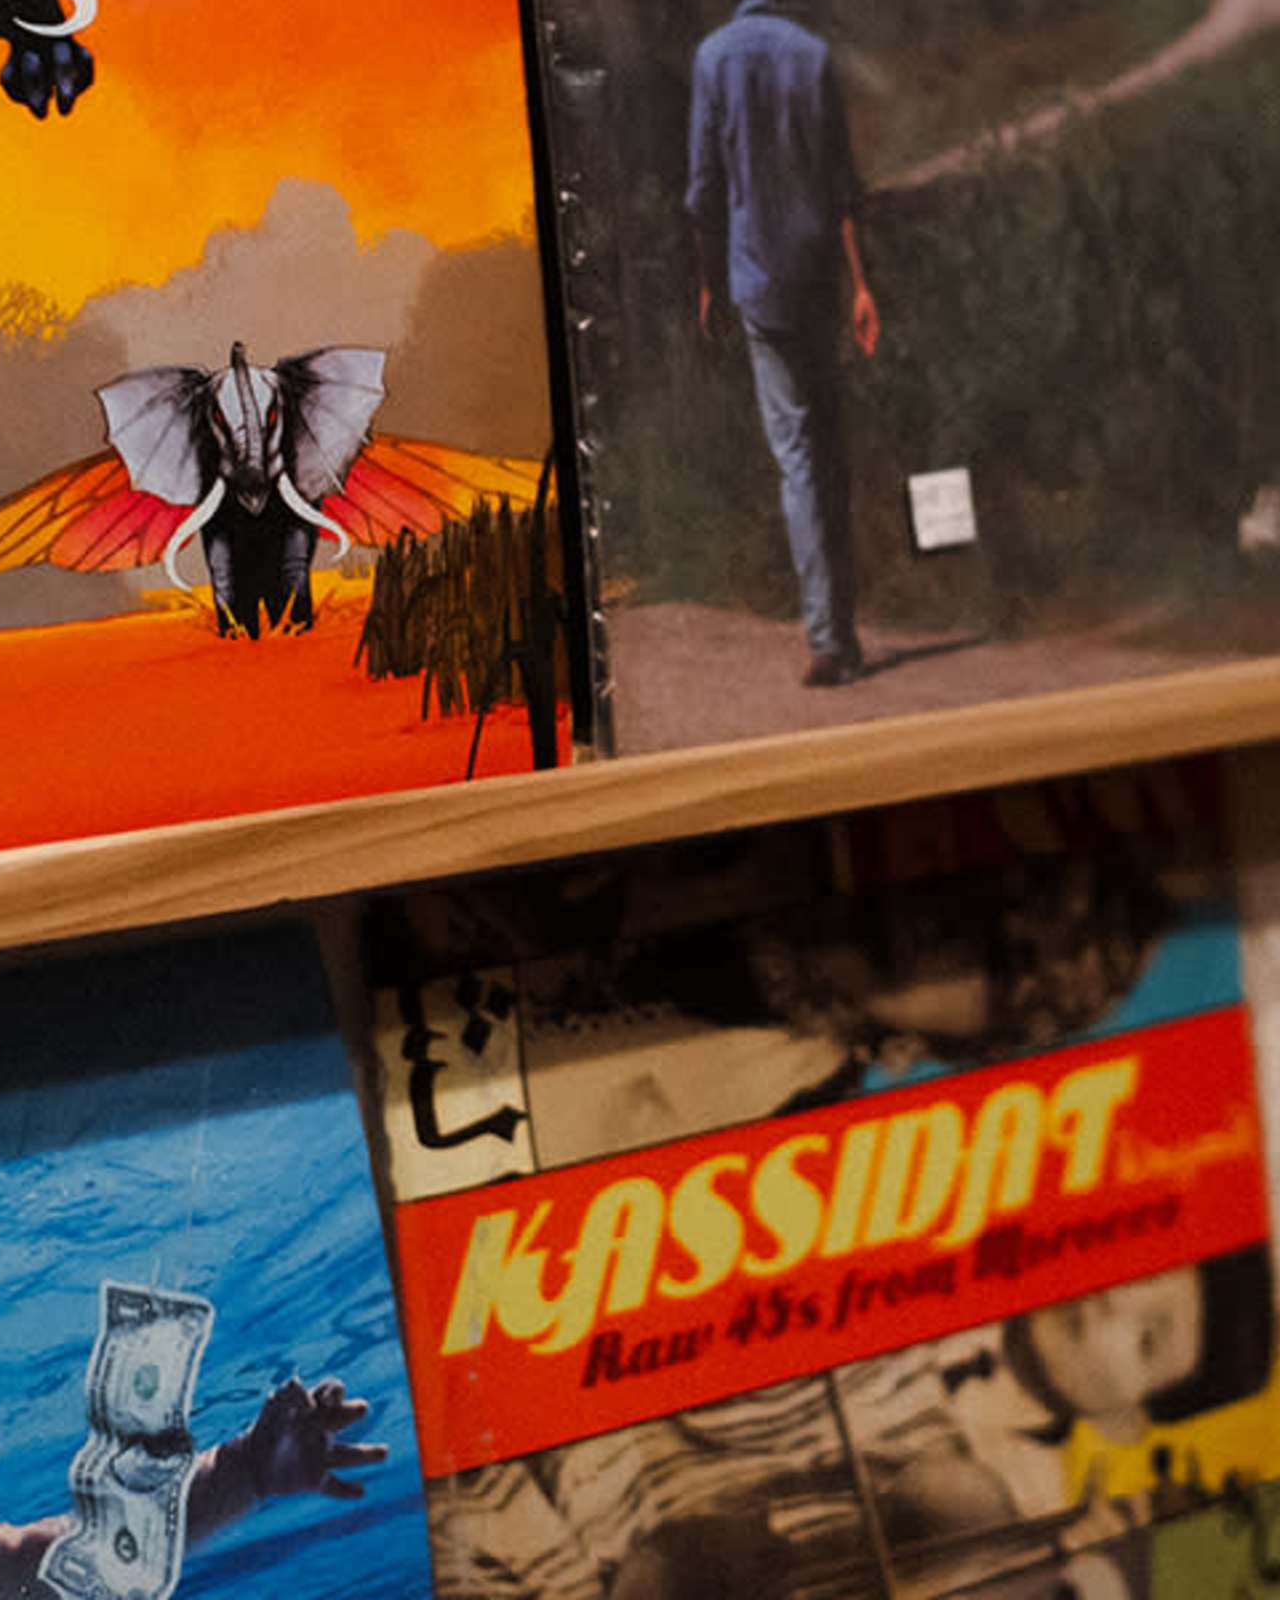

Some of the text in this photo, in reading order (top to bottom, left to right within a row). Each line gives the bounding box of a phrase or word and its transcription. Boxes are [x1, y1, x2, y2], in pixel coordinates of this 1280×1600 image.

[439, 1056, 1139, 1357] KASSIDAT
[582, 1194, 1182, 1389] Raw 45s from Morocco
